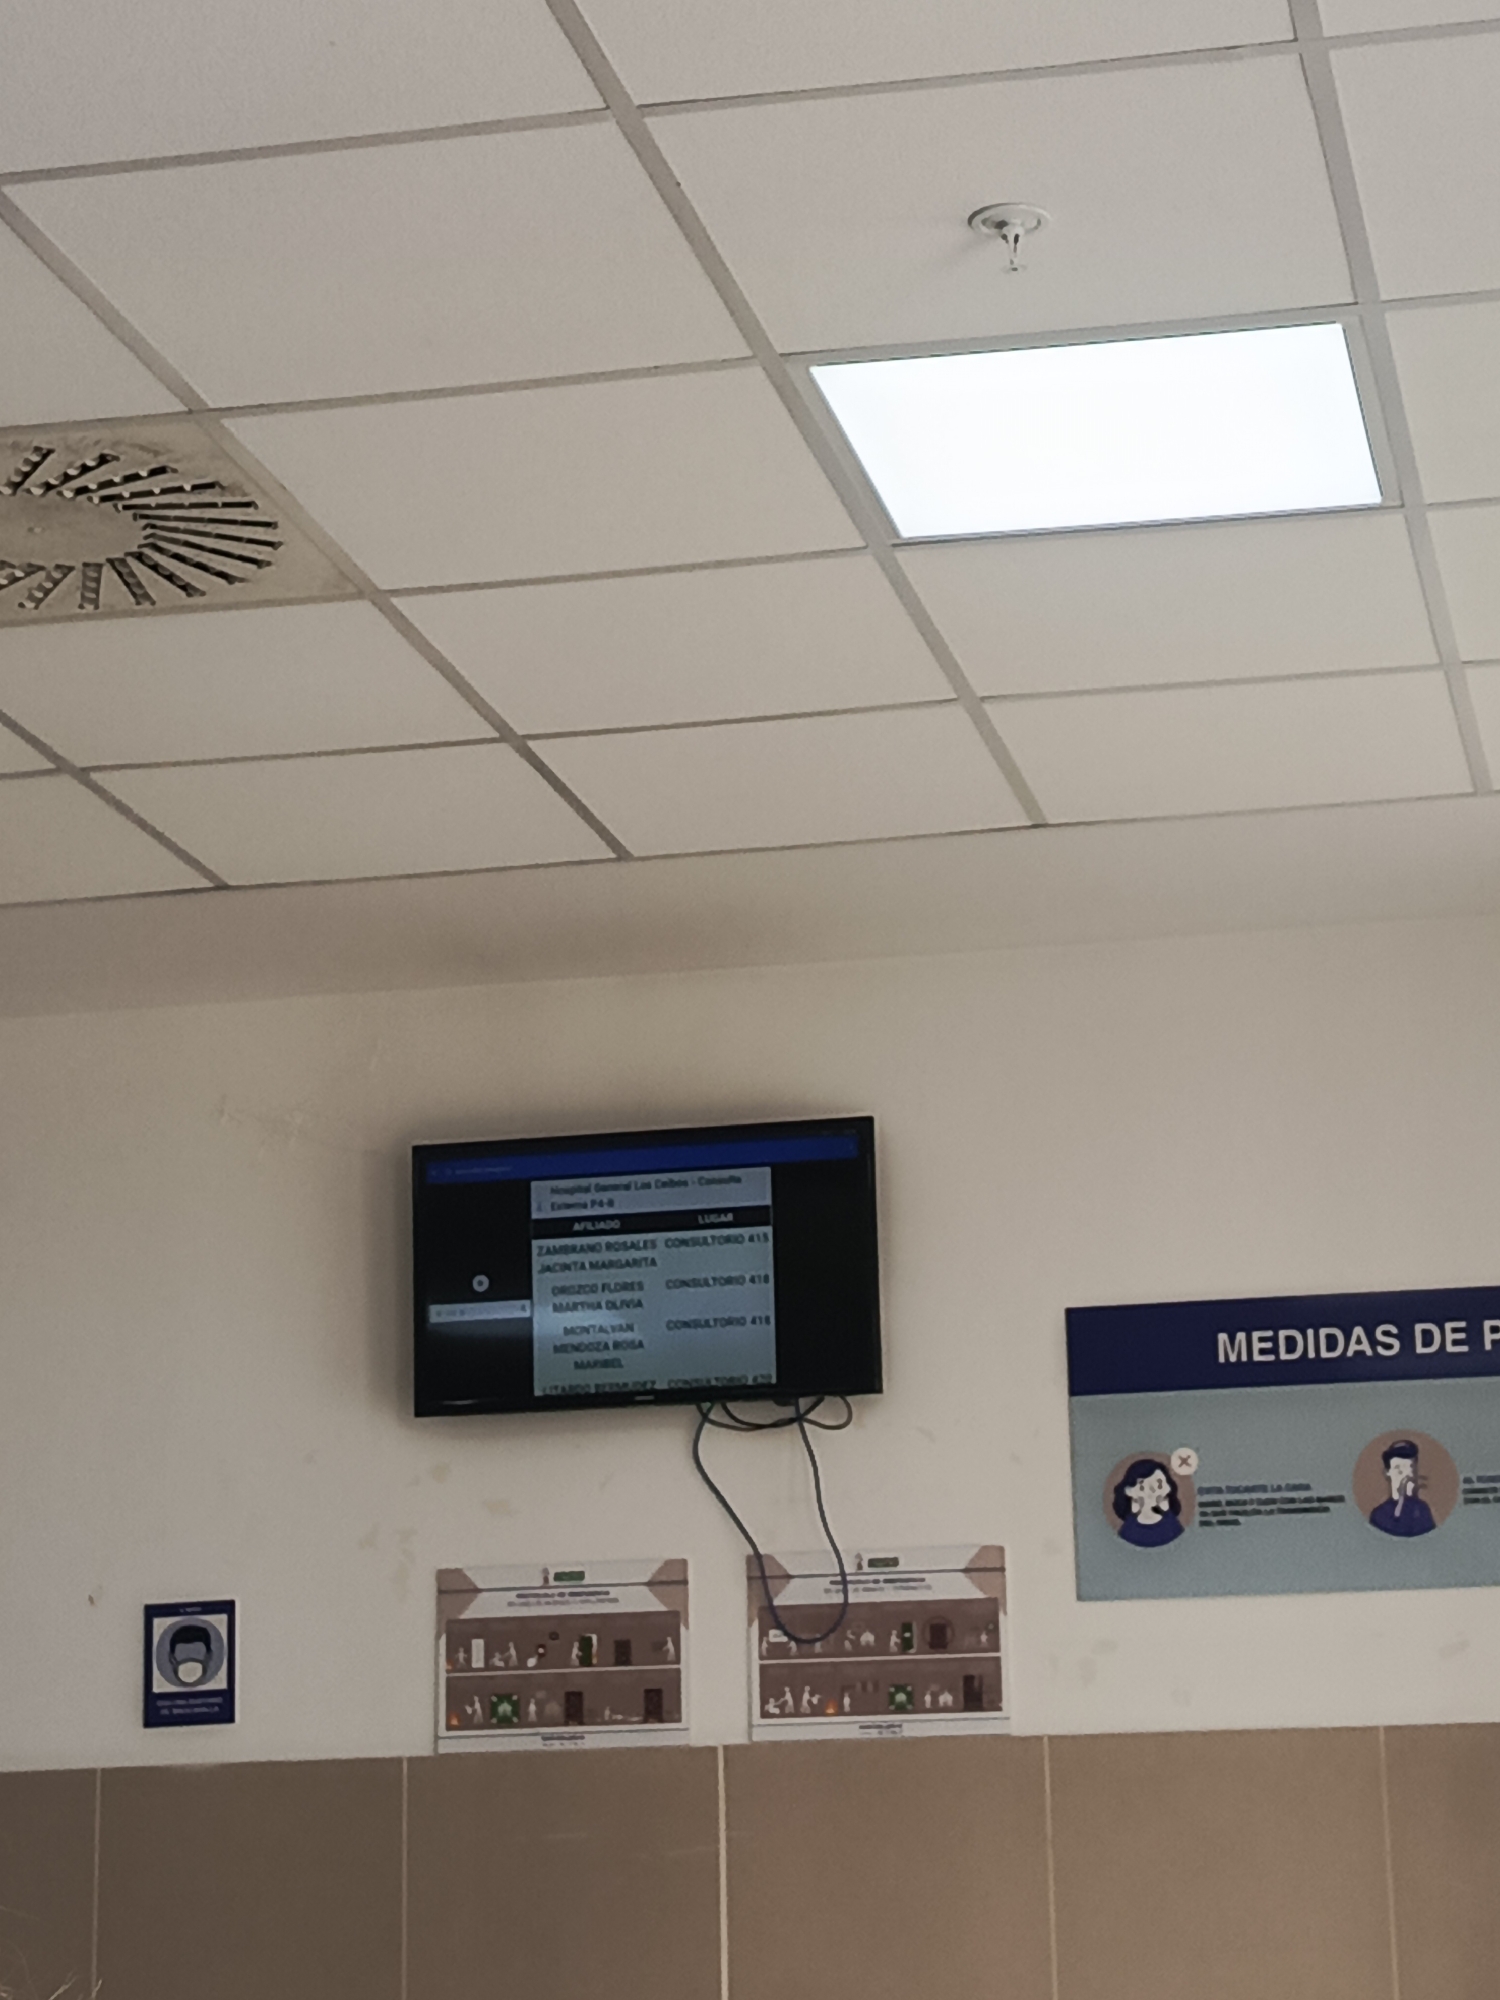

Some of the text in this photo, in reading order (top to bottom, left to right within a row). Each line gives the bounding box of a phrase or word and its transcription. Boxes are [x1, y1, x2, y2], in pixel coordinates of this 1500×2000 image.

[572, 1220, 621, 1231] AFILIADO
[698, 1213, 734, 1224] LUGAR
[537, 1239, 657, 1257] ZAMBRANO ROSALES
[665, 1234, 745, 1249] CONSULTORIO
[538, 1257, 658, 1275] JACINTA MARGARITA
[551, 1280, 644, 1297] OROZCO FLORES
[665, 1275, 746, 1290] CONSULTORIO
[552, 1301, 603, 1313] MARTHA
[666, 1317, 747, 1331] CONSULTORIO
[553, 1339, 645, 1354] MENDOZA ROSA
[1217, 1323, 1401, 1363] MEDIDAS
[1414, 1321, 1470, 1354] DE
[573, 1358, 624, 1370] MARIBEL
